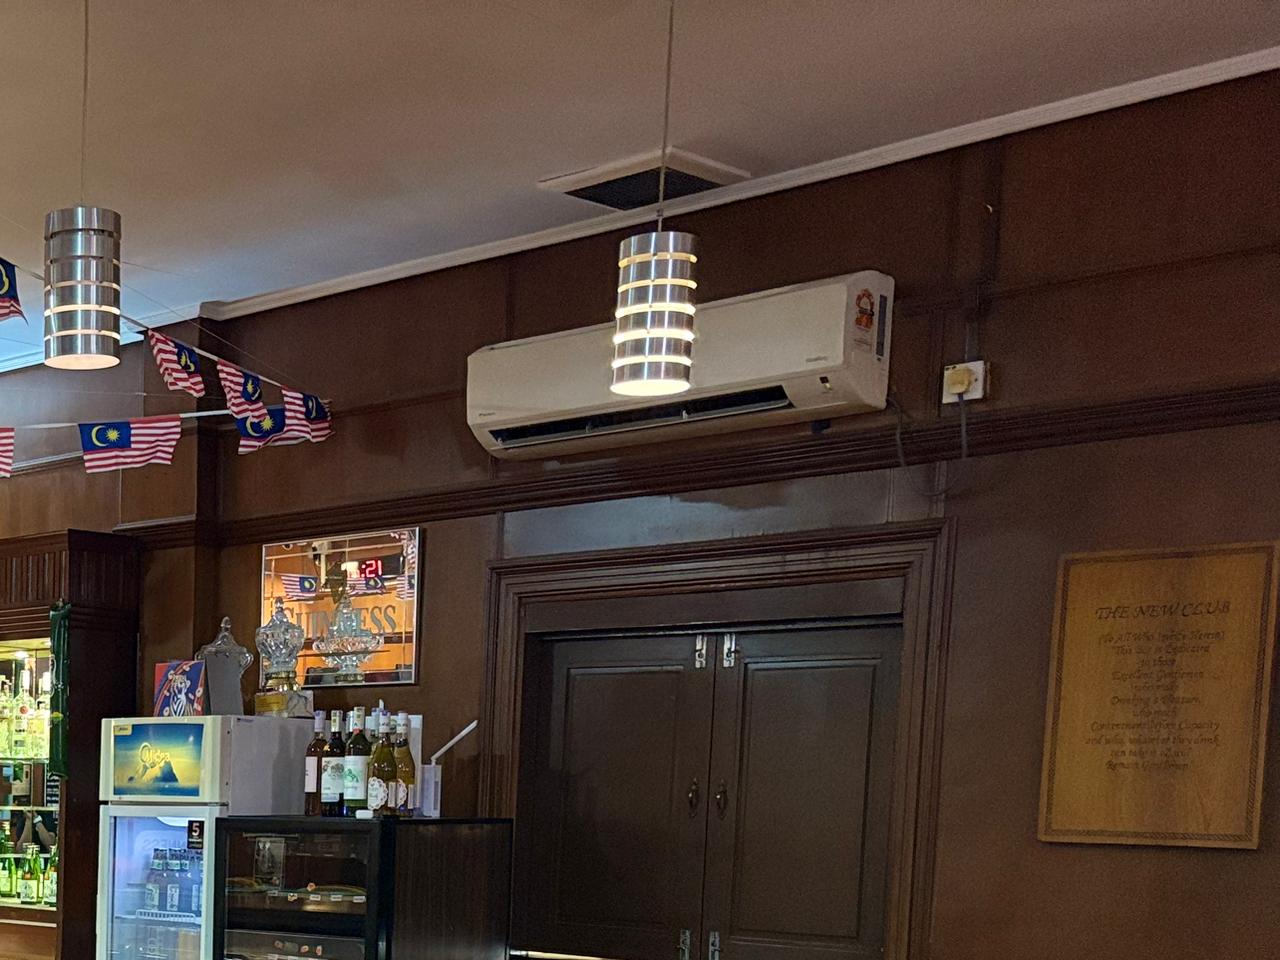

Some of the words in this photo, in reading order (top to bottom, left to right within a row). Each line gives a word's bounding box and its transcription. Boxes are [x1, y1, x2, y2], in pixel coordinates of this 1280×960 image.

[1095, 605, 1131, 620] THE
[1133, 602, 1180, 619] NEW
[1181, 600, 1231, 617] CLUB
[192, 822, 200, 836] 5
